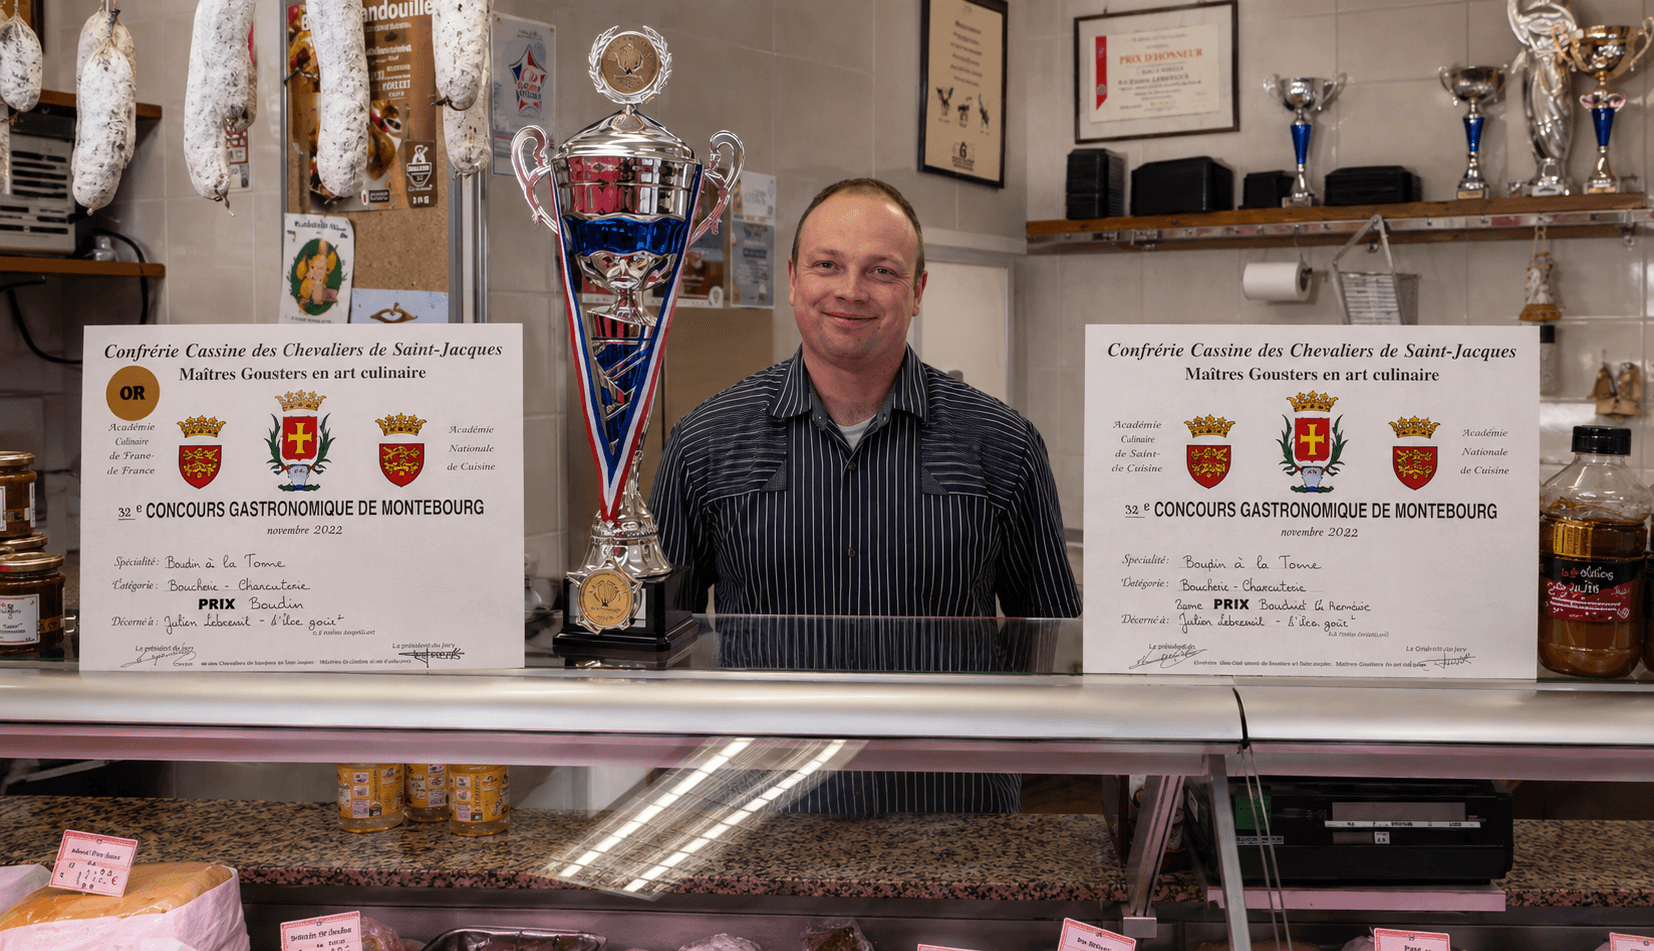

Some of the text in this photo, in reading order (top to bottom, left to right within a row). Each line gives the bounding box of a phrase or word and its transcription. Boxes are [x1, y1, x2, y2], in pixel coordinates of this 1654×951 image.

[1119, 55, 1141, 65] PRIX
[105, 342, 502, 362] Confrérie Cassine des Chevaliers de Saint-Jacques
[1108, 343, 1516, 361] Confrérie Cassine des Chevaliers de Saint-Jacques
[180, 366, 426, 380] Maîtres Gousters en art culinaire
[1186, 367, 1439, 381] Maîtres Gousters en art culinaire
[120, 385, 145, 400] OR
[109, 423, 155, 431] Académie
[1113, 421, 1162, 429] Académie
[1121, 435, 1155, 443] Culinaire
[449, 444, 494, 452] Nationale
[1462, 448, 1508, 456] Nationale
[109, 451, 120, 460] de
[1115, 449, 1161, 458] de Saint-
[107, 466, 155, 475] de France
[1111, 464, 1163, 473] de Cuisine
[1460, 466, 1509, 474] de Cuisine
[119, 508, 131, 517] 32
[146, 501, 225, 518] CONCOURS
[229, 500, 353, 517] GASTRONOMIQUE
[359, 500, 377, 515] DE
[382, 499, 484, 515] MONTEBOURG
[1125, 505, 1138, 514] 32
[1155, 501, 1236, 517] CONCOURS
[1241, 502, 1367, 519] GASTRONOMIQUE
[1372, 503, 1390, 518] DE
[1396, 503, 1497, 519] MONTEBOURG
[267, 525, 342, 534] novembre 2022
[1281, 527, 1358, 537] novembre 2022
[165, 556, 200, 568] Boudin
[206, 558, 214, 568] à
[223, 555, 237, 568] la
[1234, 557, 1245, 568] à
[1257, 555, 1269, 569] la
[199, 596, 304, 610] PRIX Boudin
[1214, 599, 1249, 610] PRIX
[1121, 614, 1158, 624] Décerné
[164, 614, 197, 635] Julien
